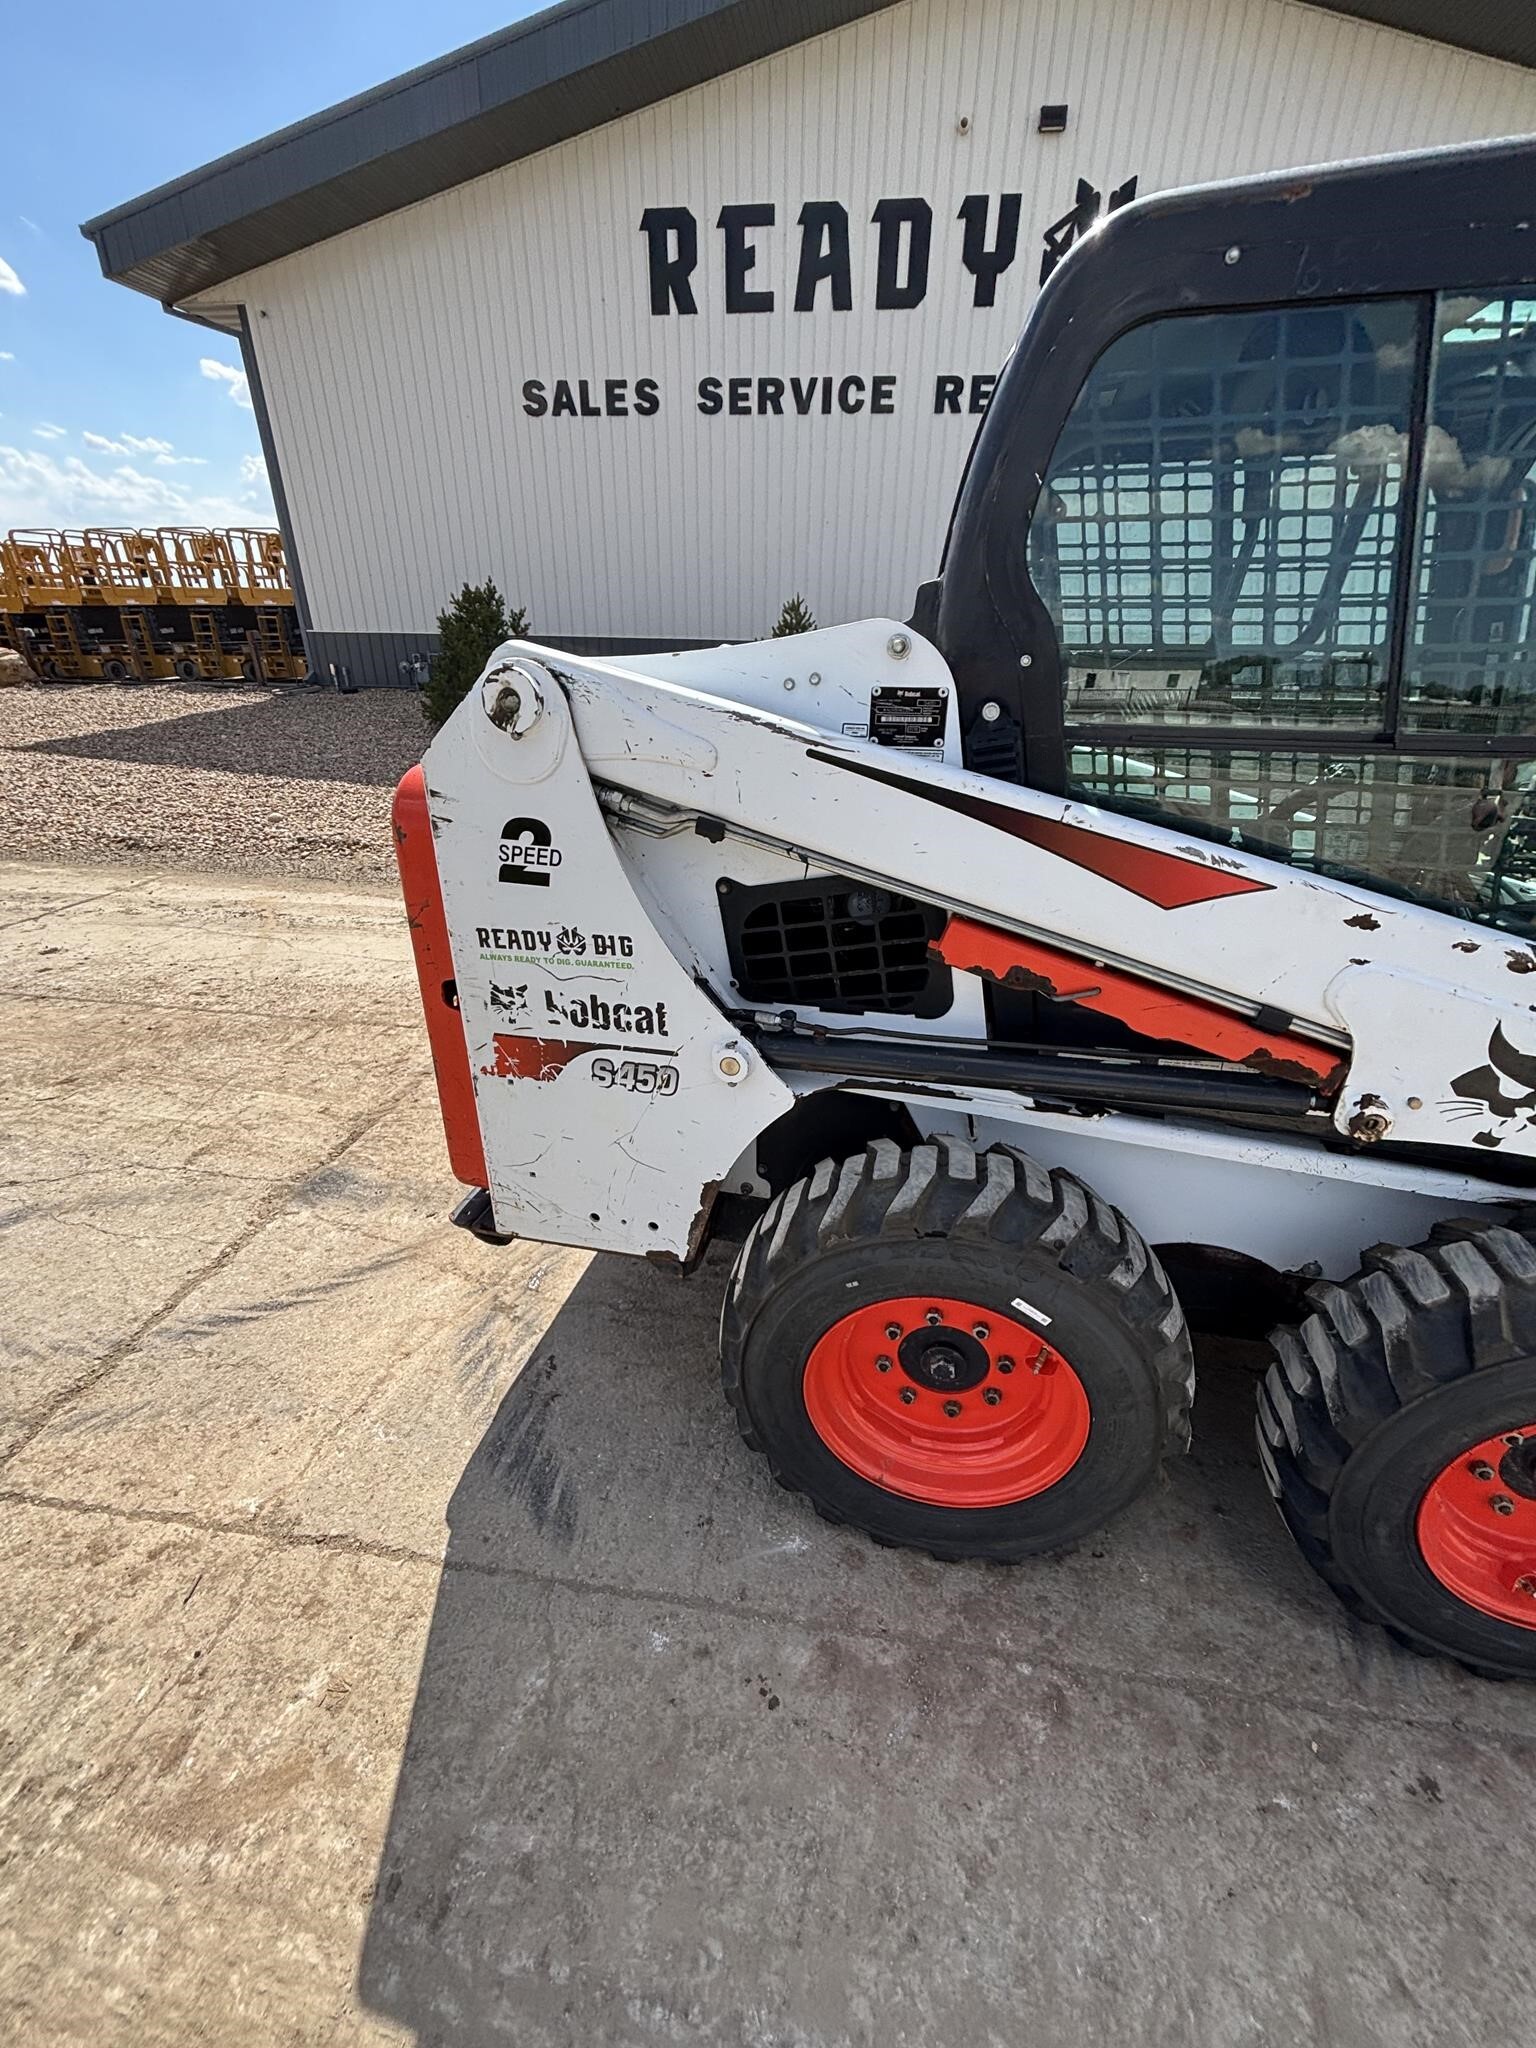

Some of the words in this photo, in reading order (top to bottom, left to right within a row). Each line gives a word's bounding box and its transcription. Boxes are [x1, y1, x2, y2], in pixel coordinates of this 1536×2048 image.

[639, 193, 1022, 315] READY
[522, 379, 660, 416] SALES
[697, 376, 897, 415] SERVICE
[498, 843, 563, 867] SPEED
[499, 816, 552, 887] 2
[475, 927, 552, 951] READY
[591, 934, 634, 957] DIG
[479, 952, 513, 963] ALWAYS
[514, 955, 541, 965] READY
[543, 956, 555, 966] TO
[556, 957, 574, 967] DIG.
[575, 959, 635, 970] GUARANTEED.
[591, 1057, 680, 1096] S450
